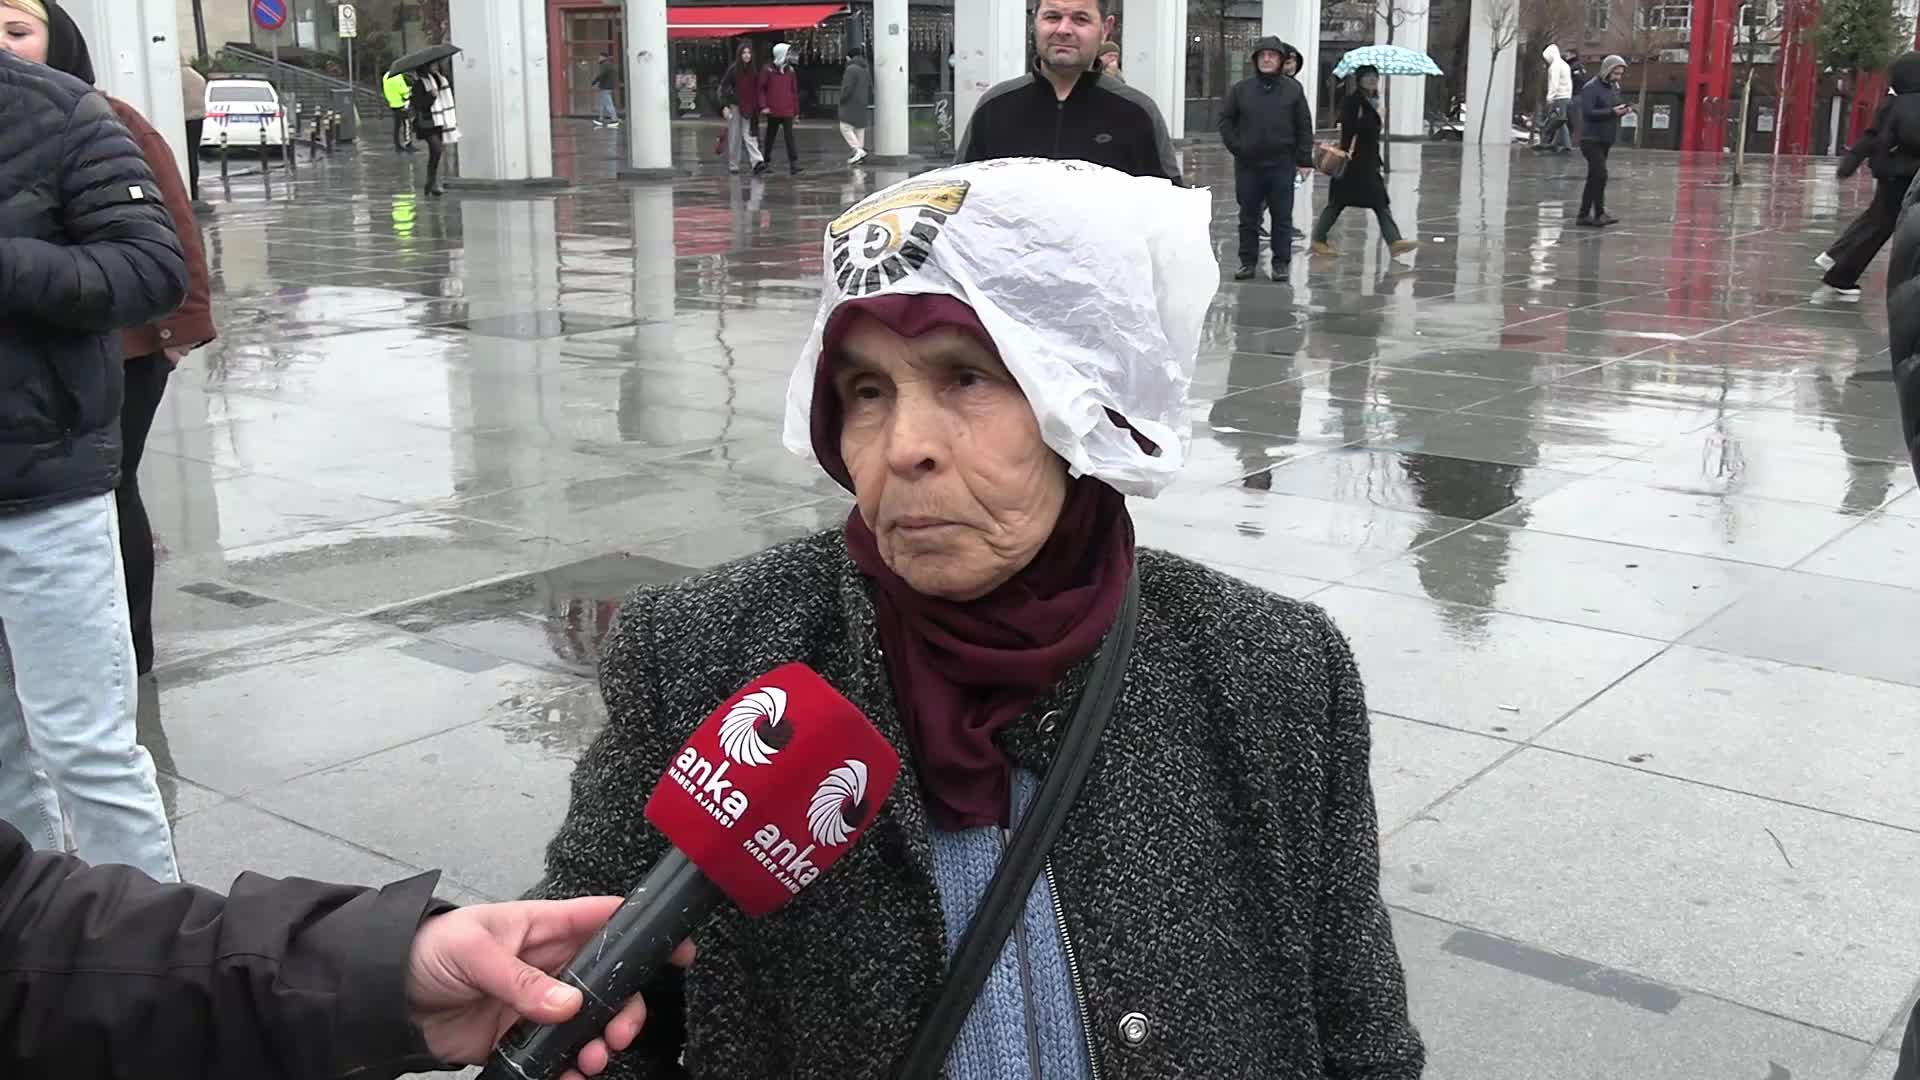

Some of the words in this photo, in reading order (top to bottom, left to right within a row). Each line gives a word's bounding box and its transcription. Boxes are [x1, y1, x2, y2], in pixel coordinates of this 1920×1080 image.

[668, 766, 697, 795] HABER
[694, 791, 735, 829] AJANSI
[676, 746, 749, 820] anka
[743, 839, 778, 873] HABER
[754, 823, 820, 888] anka
